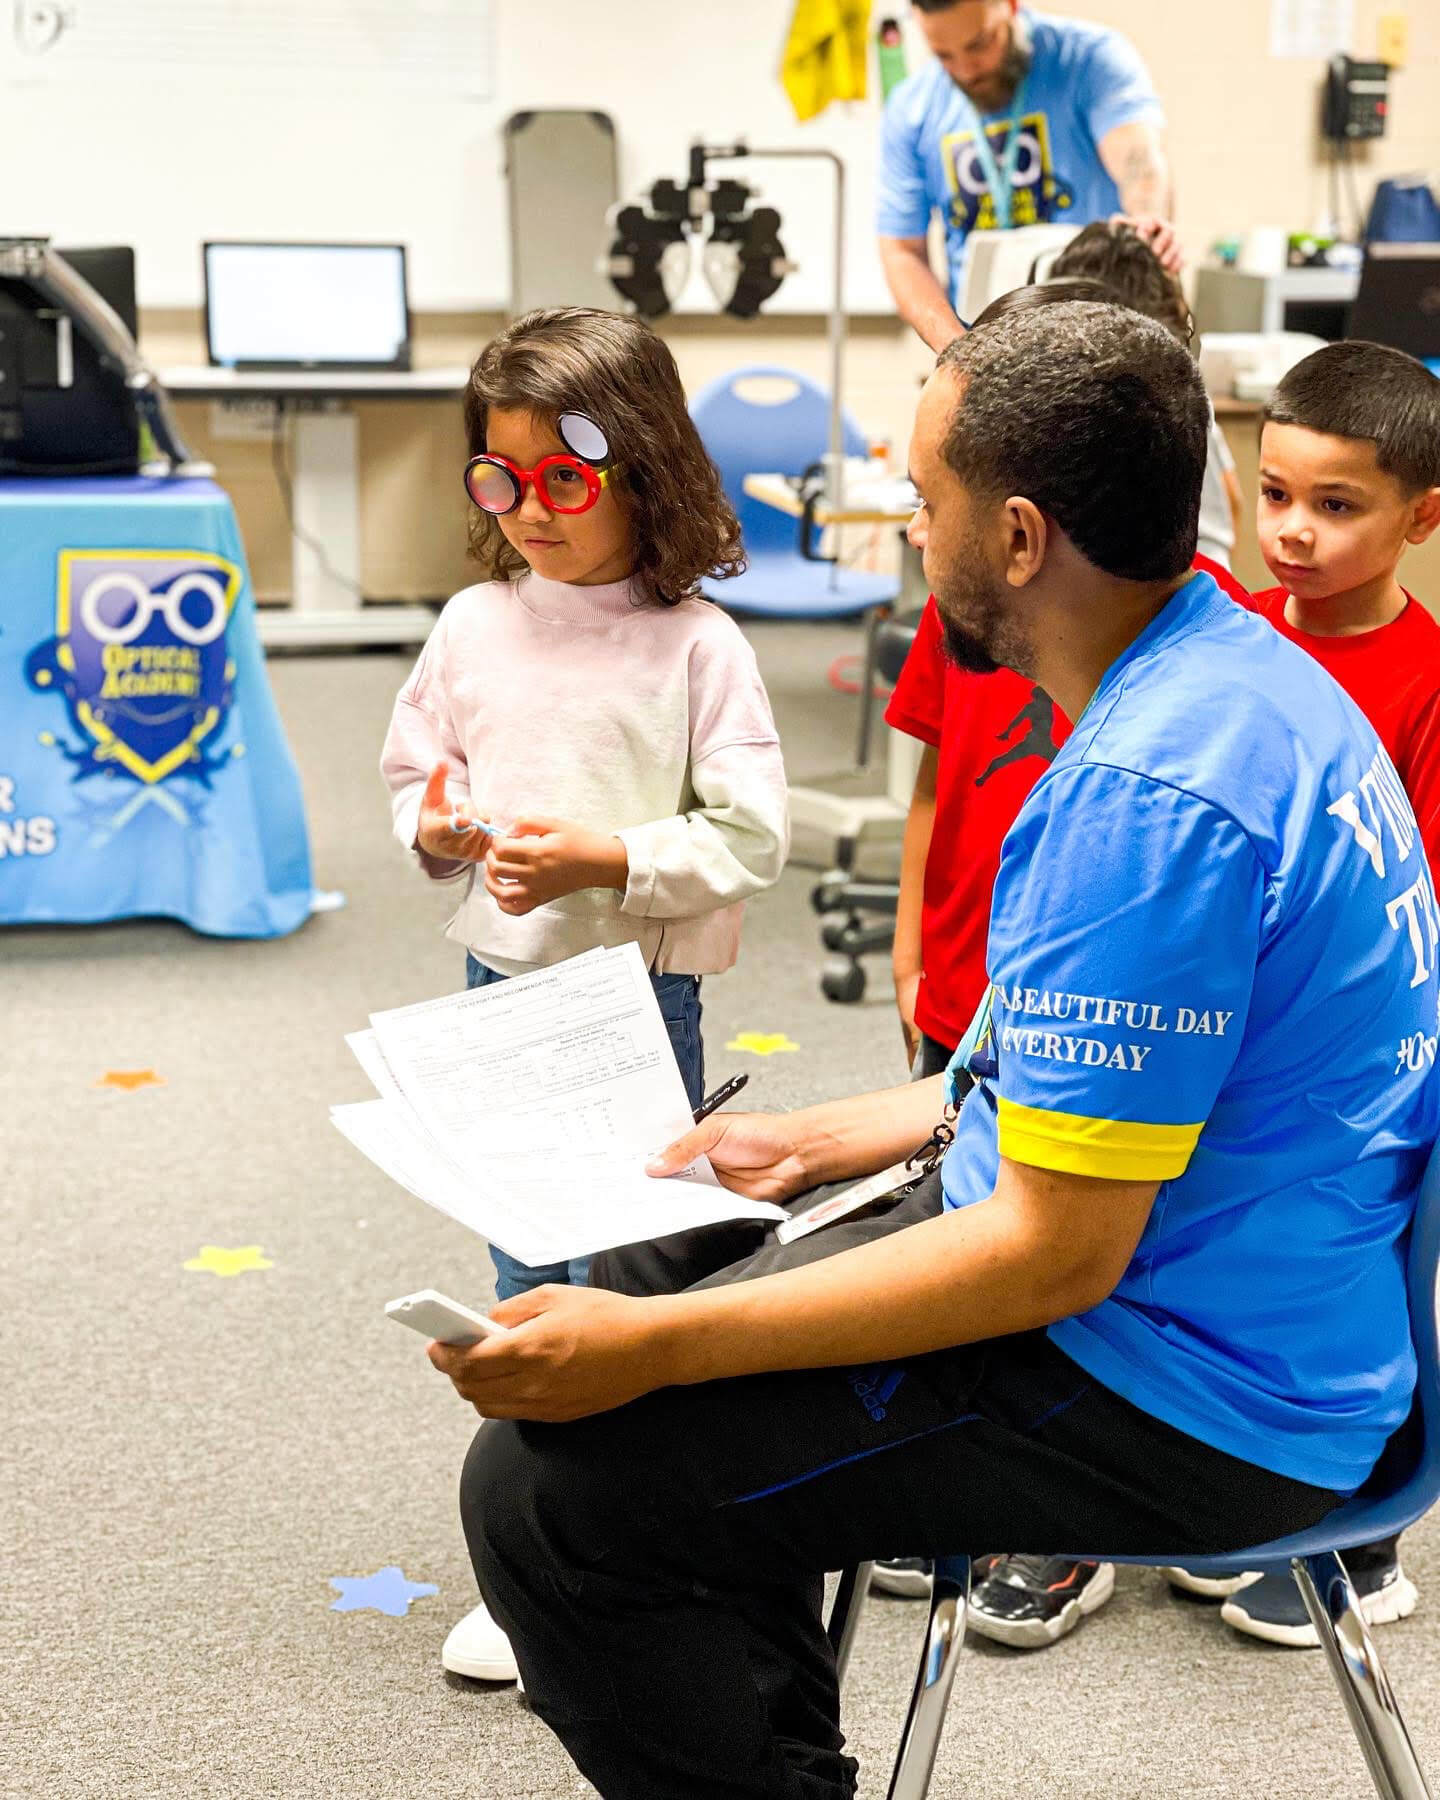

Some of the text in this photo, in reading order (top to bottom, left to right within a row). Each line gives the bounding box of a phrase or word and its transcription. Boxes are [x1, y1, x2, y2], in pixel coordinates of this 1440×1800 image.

[1012, 986, 1168, 1033] BEAUTIFUL
[1174, 1007, 1233, 1036] DAY
[1003, 1026, 1152, 1071] EVERYDAY
